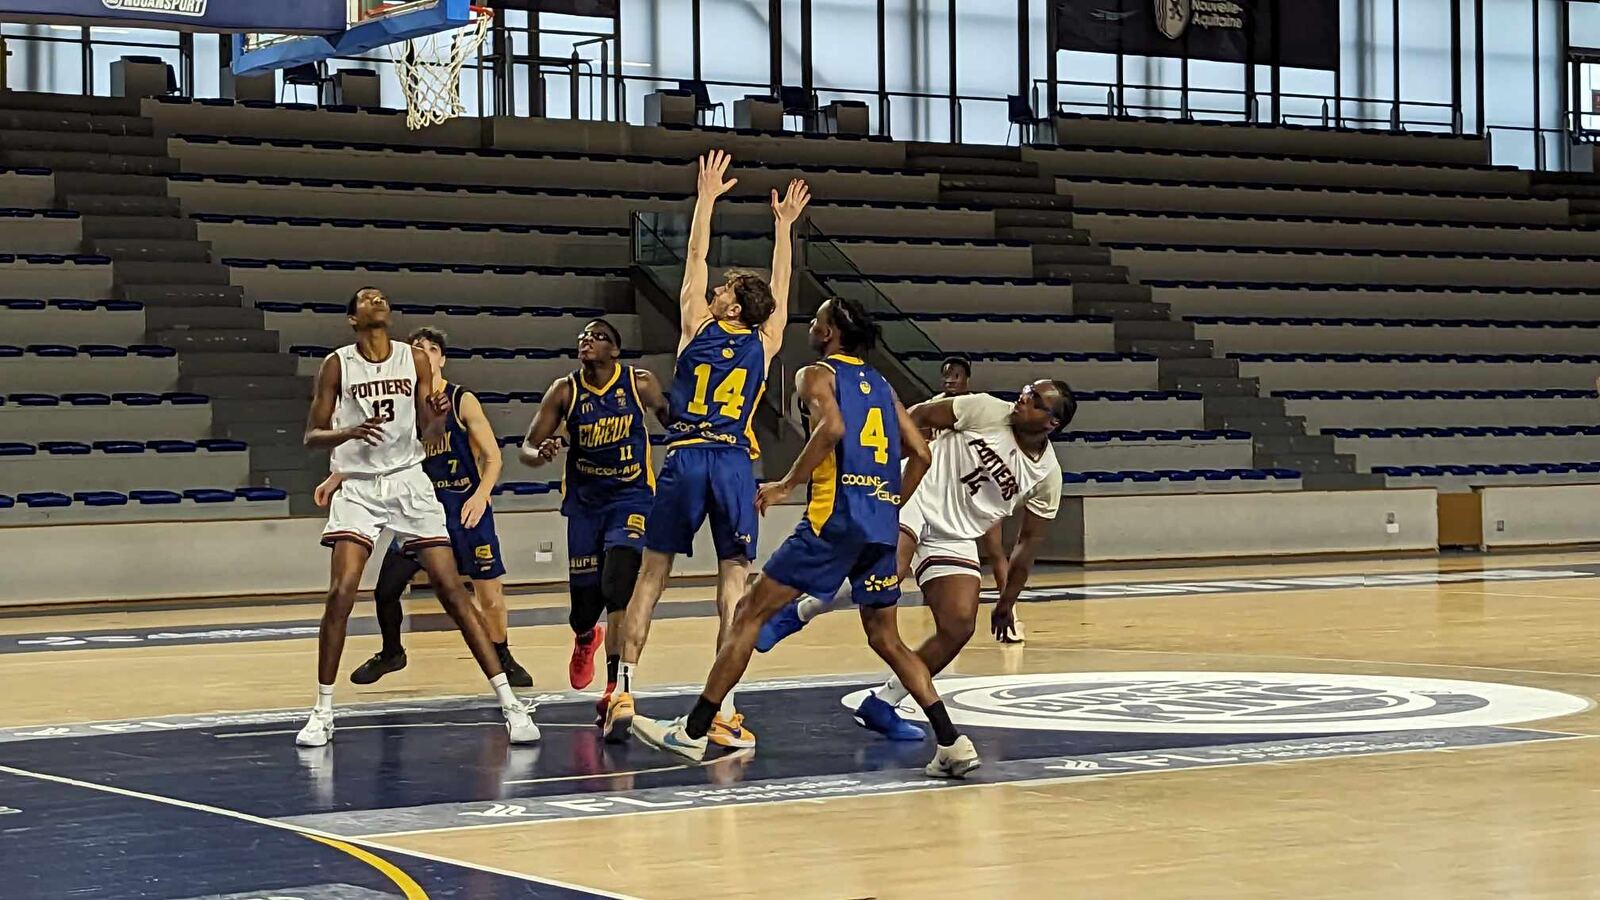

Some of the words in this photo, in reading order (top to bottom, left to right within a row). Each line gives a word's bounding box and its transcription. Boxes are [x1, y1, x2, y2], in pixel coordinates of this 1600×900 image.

[350, 378, 412, 399] POITIERS
[687, 363, 747, 420] 14
[372, 398, 395, 422] 13
[860, 407, 888, 465] 4
[447, 459, 459, 474] 7
[619, 445, 633, 461] 11
[960, 466, 991, 497] 14
[968, 438, 1019, 501] POITIERS
[997, 679, 1289, 713] BURGER
[1081, 684, 1388, 722] KING
[547, 796, 694, 813] FL
